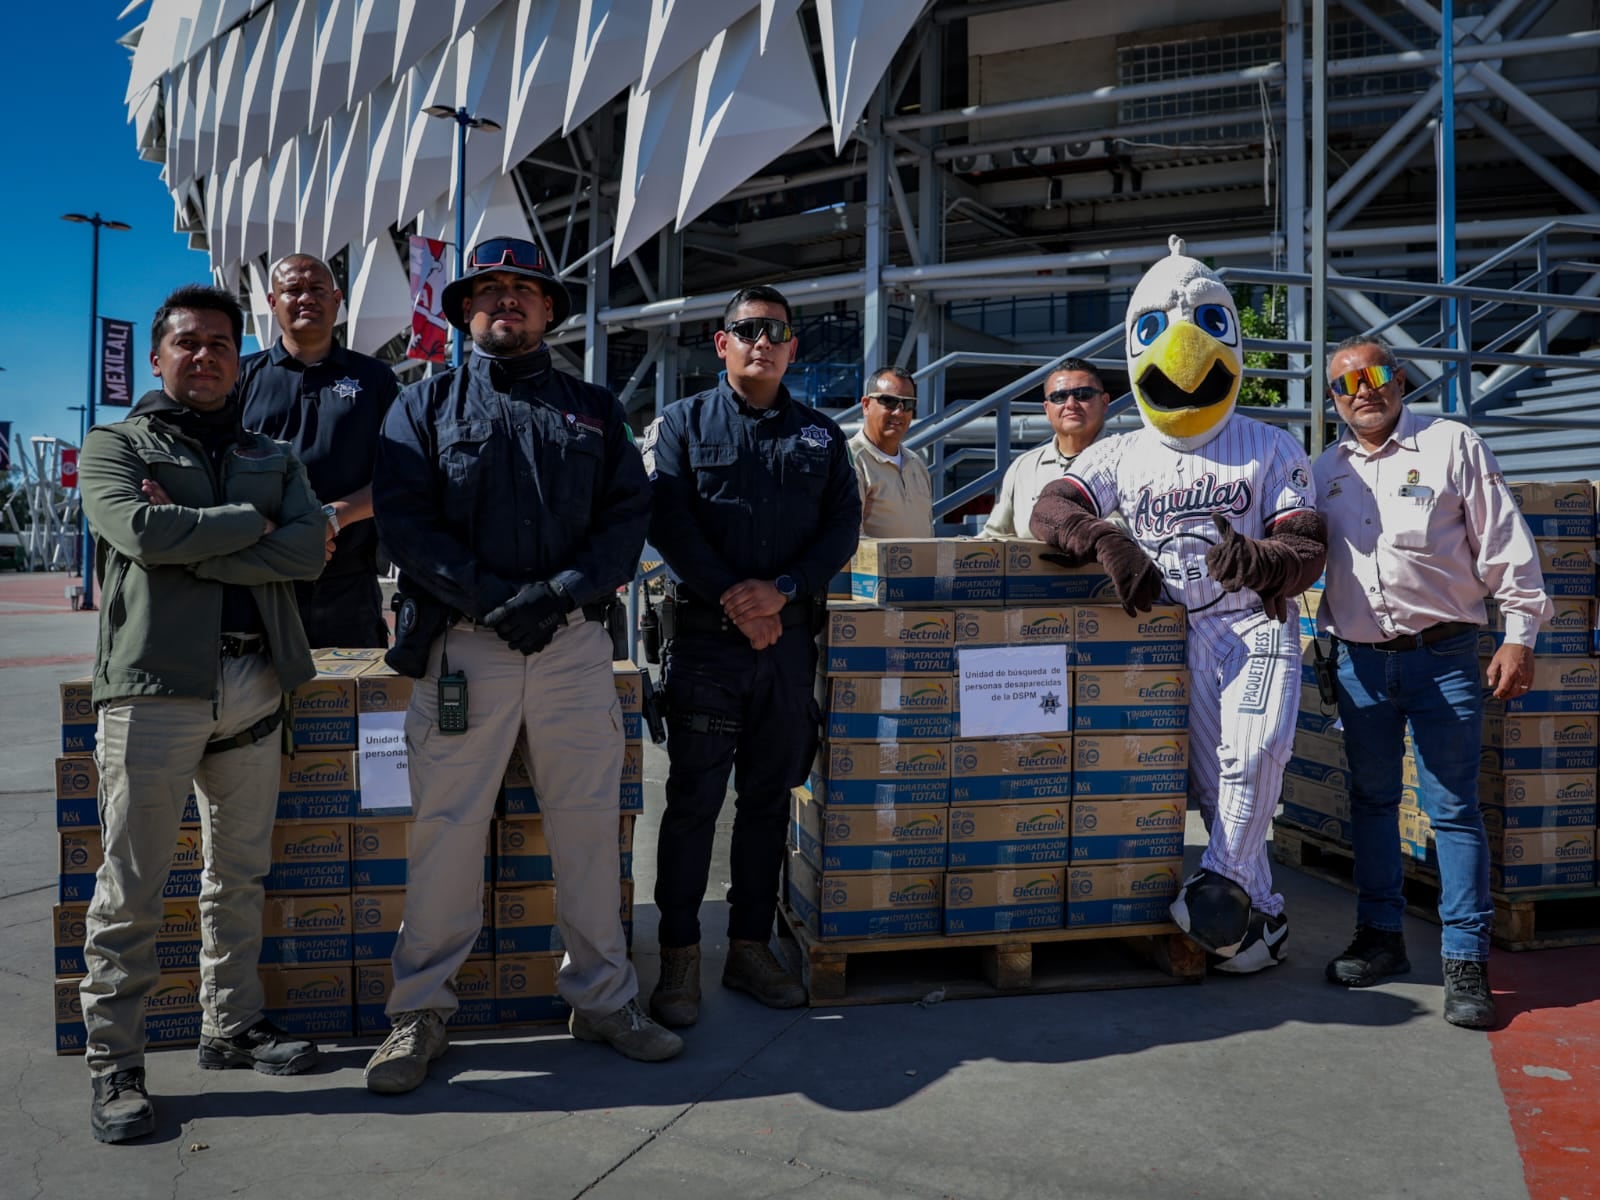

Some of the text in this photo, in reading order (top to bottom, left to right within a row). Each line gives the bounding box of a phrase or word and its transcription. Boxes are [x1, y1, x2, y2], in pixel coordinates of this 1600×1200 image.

[104, 323, 130, 400] MEXICALI
[1555, 494, 1591, 508] Electrolit
[954, 554, 1000, 569] Electrolit
[1552, 555, 1591, 568] Electrolit
[1138, 620, 1183, 633] Electrolit
[1551, 612, 1587, 626] Electrolit
[899, 625, 951, 640] Electrolit
[1020, 619, 1070, 636] Electrolit
[965, 670, 994, 678] Unidad
[1008, 668, 1047, 676] búsqueda
[1051, 667, 1061, 675] de
[1243, 632, 1271, 703] PAQUETERESS
[965, 679, 1062, 691] personas desaparecidas
[1561, 671, 1597, 683] Electrolit
[900, 690, 949, 706] Electrolit
[1003, 693, 1011, 701] la
[1013, 692, 1037, 700] DSPM
[1139, 684, 1185, 698] Electrolit
[366, 736, 399, 745] Unidad
[1554, 726, 1592, 740] Electrolit
[1018, 750, 1068, 767] Electrolit
[1138, 747, 1184, 763] Electrolit
[896, 756, 947, 772] Electrolit
[288, 765, 349, 784] Electrolit
[1556, 784, 1593, 799] Electrolit
[1016, 816, 1066, 832] Electrolit
[1136, 811, 1183, 827] Electrolit
[893, 821, 944, 837] Electrolit
[284, 837, 344, 855] Electrolit
[1555, 841, 1592, 857] Electrolit
[165, 883, 201, 895] OTAL!
[1013, 881, 1061, 897] Electrolit
[1131, 874, 1177, 891] Electrolit
[889, 888, 938, 902] Electrolit
[158, 915, 198, 933] ctrolit
[288, 909, 344, 928] Electrolit
[287, 981, 345, 1000] Electrolit
